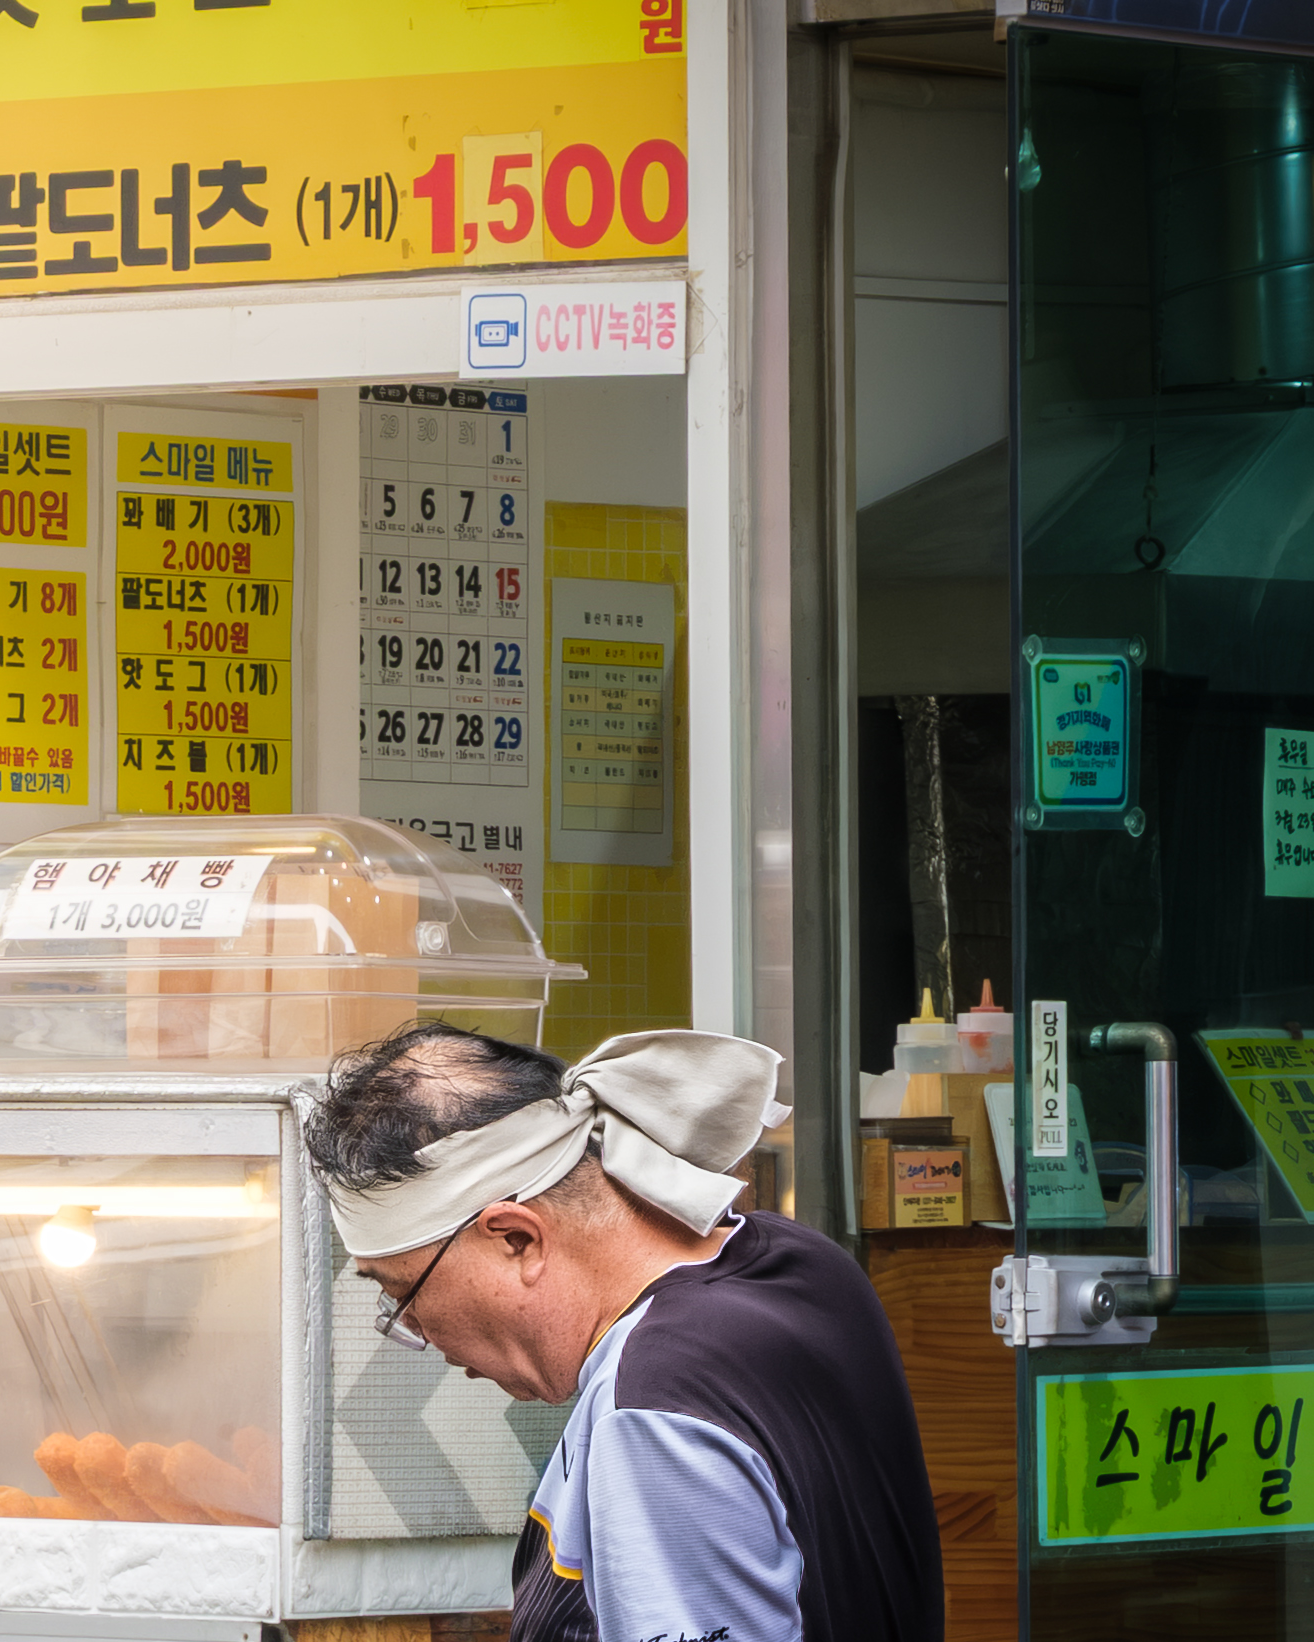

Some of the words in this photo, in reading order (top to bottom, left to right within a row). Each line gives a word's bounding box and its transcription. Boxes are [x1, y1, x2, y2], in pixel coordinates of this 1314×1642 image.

[295, 171, 400, 248] (1개)
[413, 138, 689, 258] 1,500
[535, 299, 678, 355] CCTV녹화중
[416, 417, 439, 442] 30
[501, 419, 512, 453] 1
[139, 441, 216, 479] 스마일
[227, 445, 275, 486] 메뉴
[227, 501, 282, 537] (3개)
[383, 484, 397, 518] 5
[420, 487, 436, 521] 6
[459, 490, 475, 524] 7
[499, 493, 516, 527] 8
[162, 539, 253, 575] 2,000원
[121, 576, 209, 614] 팥도너츠
[225, 581, 280, 617] (1개)
[378, 559, 403, 594] 12
[416, 561, 442, 596] 13
[455, 564, 483, 599] 14
[495, 567, 521, 601] 15
[40, 581, 79, 617] 8개
[40, 637, 79, 672] 2개
[162, 619, 250, 655] 1,500원
[377, 634, 404, 669] 19
[415, 636, 444, 671] 20
[457, 639, 481, 674] 21
[493, 641, 522, 676] 22
[224, 662, 279, 697] (1개)
[41, 693, 80, 728] 2개
[162, 699, 250, 735] 1,500원
[377, 709, 407, 744] 26
[417, 711, 445, 746] 27
[455, 713, 485, 748] 28
[493, 716, 523, 750] 29
[46, 747, 74, 770] 있음
[225, 742, 280, 775] (1개)
[10, 772, 72, 795] 할인가격)
[163, 779, 252, 814] 1,500원
[1069, 771, 1098, 787] 가맹점
[1276, 777, 1297, 798] 매주
[483, 825, 523, 852] 별내
[47, 901, 89, 933] 1개
[99, 898, 207, 934] 3,000원
[1042, 1011, 1060, 1120] 당기시오
[1040, 1129, 1064, 1145] PULL
[1095, 1397, 1304, 1516] 스마일
